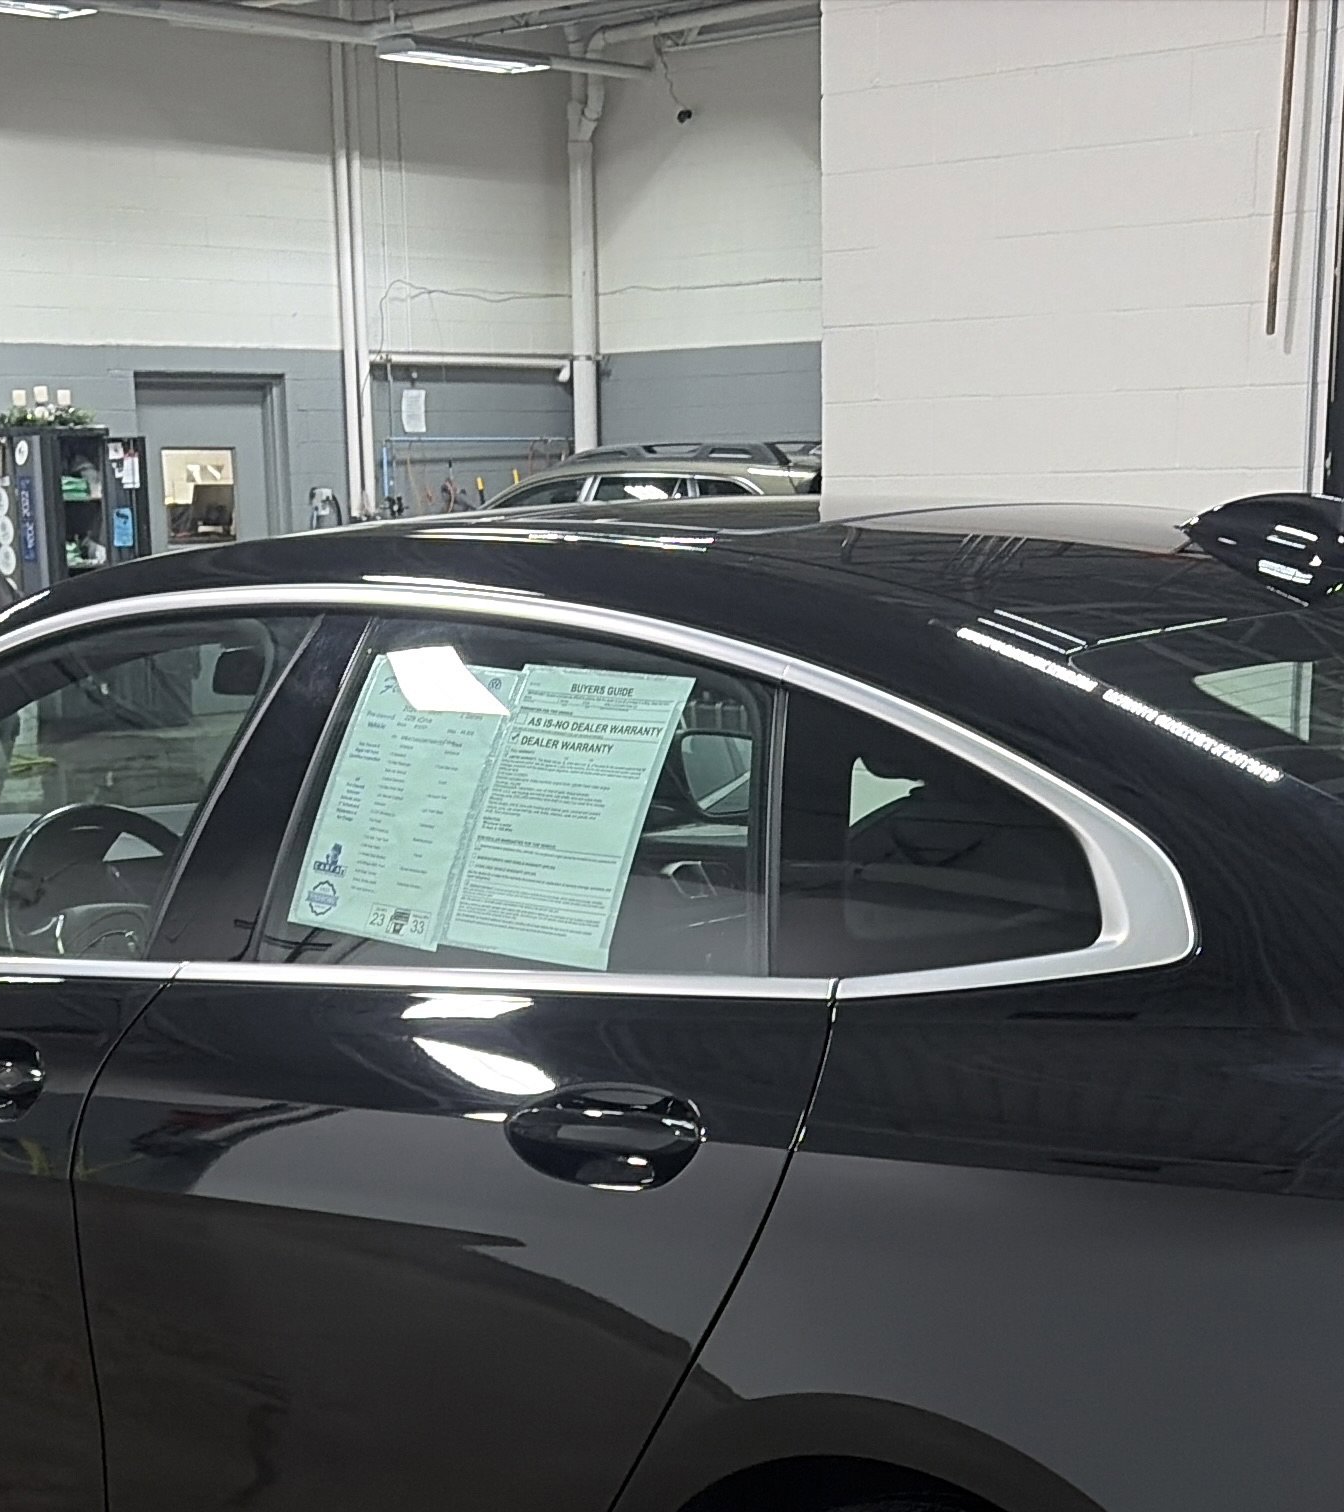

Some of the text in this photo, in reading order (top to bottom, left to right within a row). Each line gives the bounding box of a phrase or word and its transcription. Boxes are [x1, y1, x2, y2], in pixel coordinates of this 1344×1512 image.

[570, 683, 635, 697] BUYERS GUIDE
[527, 717, 541, 727] AS
[543, 718, 570, 730] IS-NO
[570, 721, 609, 733] DEALER
[609, 724, 663, 738] WARRANTY
[520, 735, 614, 755] DEALER WARRANTY
[369, 912, 386, 927] 23
[410, 919, 425, 935] 33
